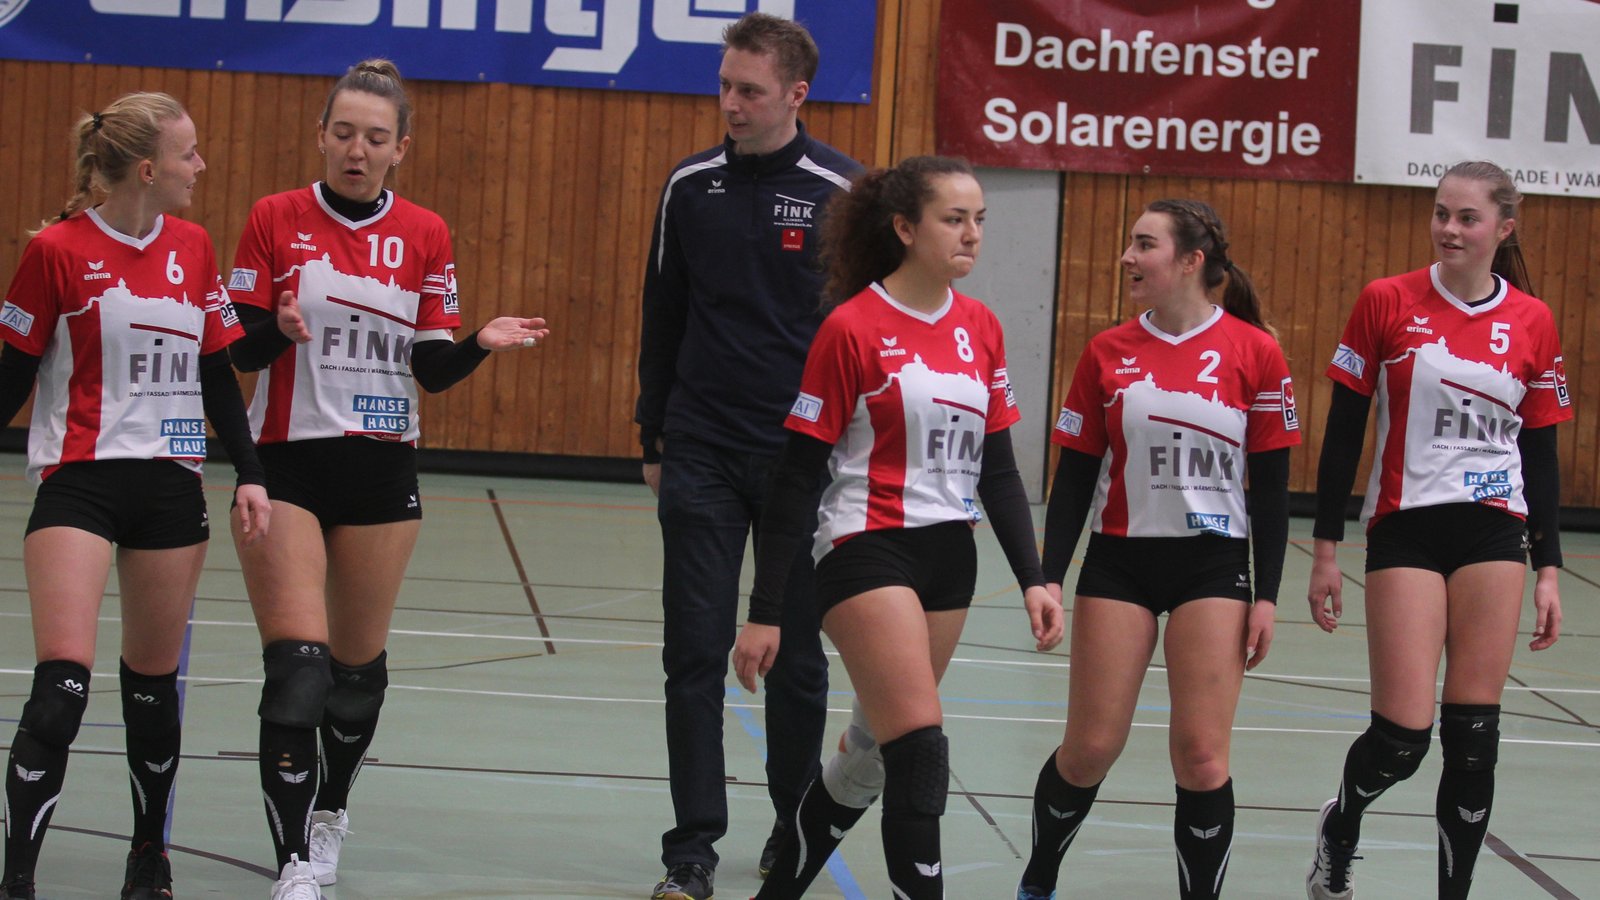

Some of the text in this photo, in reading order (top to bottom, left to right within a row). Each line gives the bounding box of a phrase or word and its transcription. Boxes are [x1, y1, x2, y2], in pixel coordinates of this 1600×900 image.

[994, 22, 1319, 80] Dachfenster
[983, 98, 1321, 165] Solarenergie
[291, 242, 317, 251] erima
[367, 233, 405, 269] 10
[166, 251, 185, 285] 6
[84, 271, 111, 281] erima
[1406, 325, 1433, 335] erima
[953, 326, 974, 363] 8
[1490, 321, 1511, 355] 5
[880, 348, 906, 358] erima
[1115, 366, 1140, 375] erima
[1197, 350, 1221, 384] 2
[358, 398, 406, 412] HANSE
[368, 417, 406, 430] HAUS
[1476, 486, 1511, 498] HAUS
